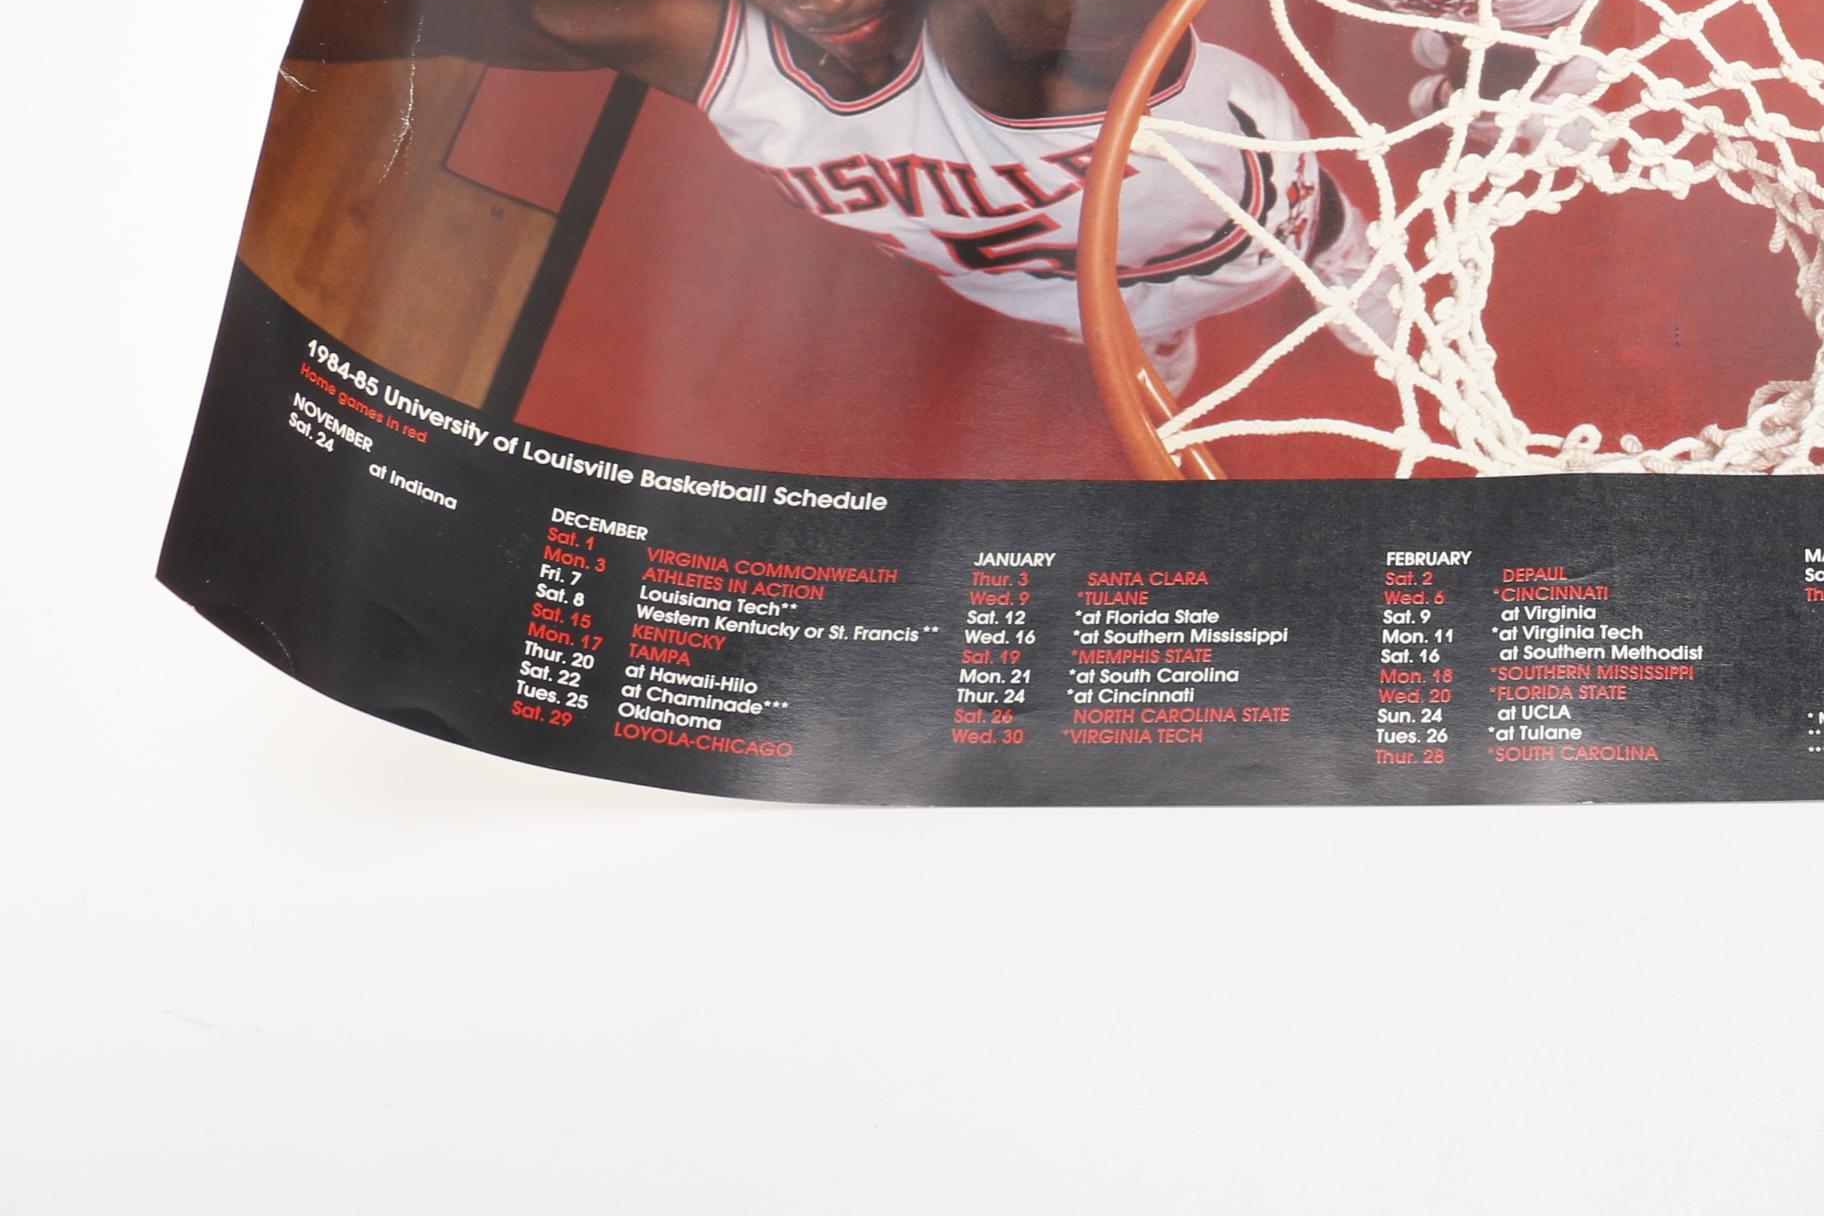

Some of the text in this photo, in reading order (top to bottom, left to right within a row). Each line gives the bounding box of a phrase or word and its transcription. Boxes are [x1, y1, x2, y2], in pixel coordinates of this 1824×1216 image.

[301, 363, 428, 443] Home games red
[293, 392, 373, 452] NOVEMBER
[309, 340, 888, 511] 1984-85 University of Louisville Basketball Schedule
[289, 412, 334, 452] Sat. 24
[369, 464, 457, 510] at Indiana
[551, 508, 648, 541] DECEMBER
[547, 527, 579, 547] Sat.
[544, 545, 589, 569] Mon.
[648, 547, 898, 583] VIRGINIA COMMONWEALTH
[974, 552, 1056, 567] JANUARY
[1386, 551, 1472, 566] FEBRUARY
[540, 564, 564, 583] Fri.
[972, 571, 1012, 586] Thur.
[1088, 571, 1209, 586] SANTA CLARA
[1385, 571, 1417, 586] Sat.
[1503, 566, 1567, 582] DEPAUL
[642, 567, 825, 600] ATHLETES ACTION
[535, 583, 568, 604] Sat.
[640, 585, 732, 611] Louisiana
[970, 591, 1013, 606] Wed.
[1384, 591, 1429, 605] Wed.
[531, 602, 591, 629] Sat. 15
[637, 604, 709, 628] Western
[714, 616, 800, 640] Kentucky
[828, 625, 848, 640] St.
[967, 610, 1026, 625] Sat. 12
[1106, 609, 1220, 624] Florida State
[1383, 609, 1415, 624] Sat.
[1524, 605, 1596, 623] Virginia
[528, 621, 603, 650] Mon. 17
[632, 624, 726, 650] KENTUCKY
[965, 629, 1036, 644] Wed. 16
[1104, 628, 1288, 645] Southern Mississippi
[1382, 629, 1453, 644] Mon. 11
[1522, 624, 1643, 642] Virginia Tech
[525, 640, 594, 669] Thur. 20
[630, 643, 690, 666] TAMPA
[961, 649, 1021, 664] Sat. 19
[1165, 648, 1212, 663] STATE
[1381, 648, 1440, 663] Sat. 16
[1523, 645, 1703, 660] Southern Methodist
[520, 660, 581, 687] Sat. 22
[650, 666, 758, 694] Hawaii-Hilo
[959, 668, 1031, 684] Mon. 21
[1099, 667, 1239, 684] South Carolina
[1380, 668, 1453, 684] Mon. 18
[1597, 665, 1693, 680] MISSISSIPPI
[517, 679, 588, 709] Tues. 25
[957, 688, 1025, 703] Thur. 24
[1098, 688, 1194, 703] Cincinnati
[1379, 688, 1452, 703] Wed. 20
[1579, 685, 1626, 700] STATE
[512, 700, 573, 726] Sat. 29
[618, 702, 722, 731] Oklahoma
[954, 708, 1014, 724] Sat. 26
[1074, 707, 1290, 724] NORTH CAROLINA STATE
[1377, 708, 1442, 723] Sun. 24
[1522, 704, 1571, 720] UCLA
[614, 722, 792, 757] LOYOLA-CHICAGO
[952, 728, 1024, 744] Wed. 30
[1158, 728, 1203, 743] TECH
[1376, 728, 1448, 744] Tues. 26
[1520, 725, 1582, 740] Tulane
[1375, 749, 1444, 764] Thur. 28
[1560, 745, 1658, 761] CAROLINA
